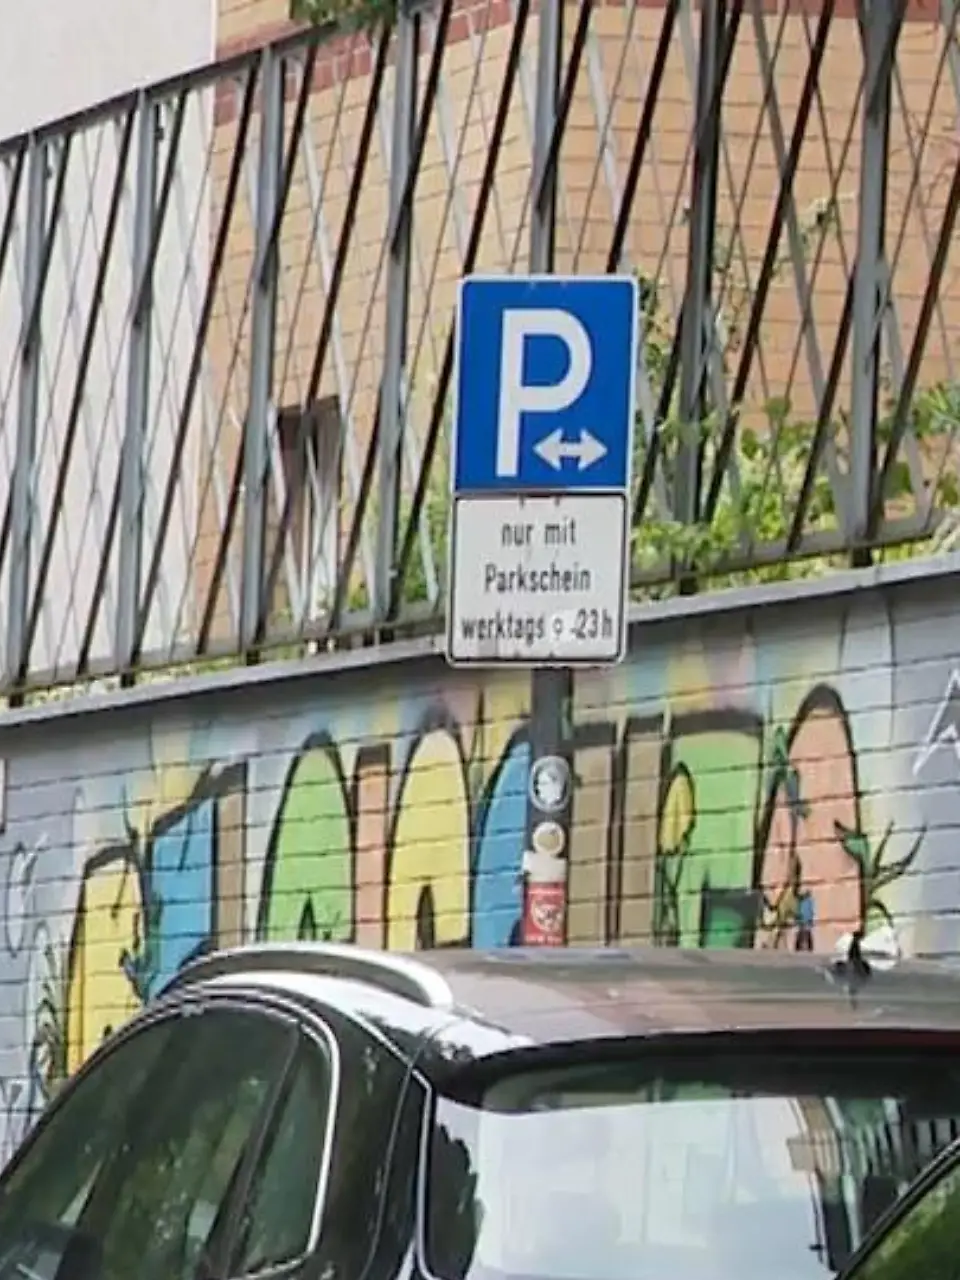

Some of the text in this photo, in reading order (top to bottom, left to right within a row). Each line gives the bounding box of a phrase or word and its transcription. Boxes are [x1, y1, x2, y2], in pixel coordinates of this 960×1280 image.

[495, 308, 592, 478] P
[501, 516, 577, 547] nur mit
[484, 563, 592, 594] Parkschein
[461, 609, 545, 648] werktags
